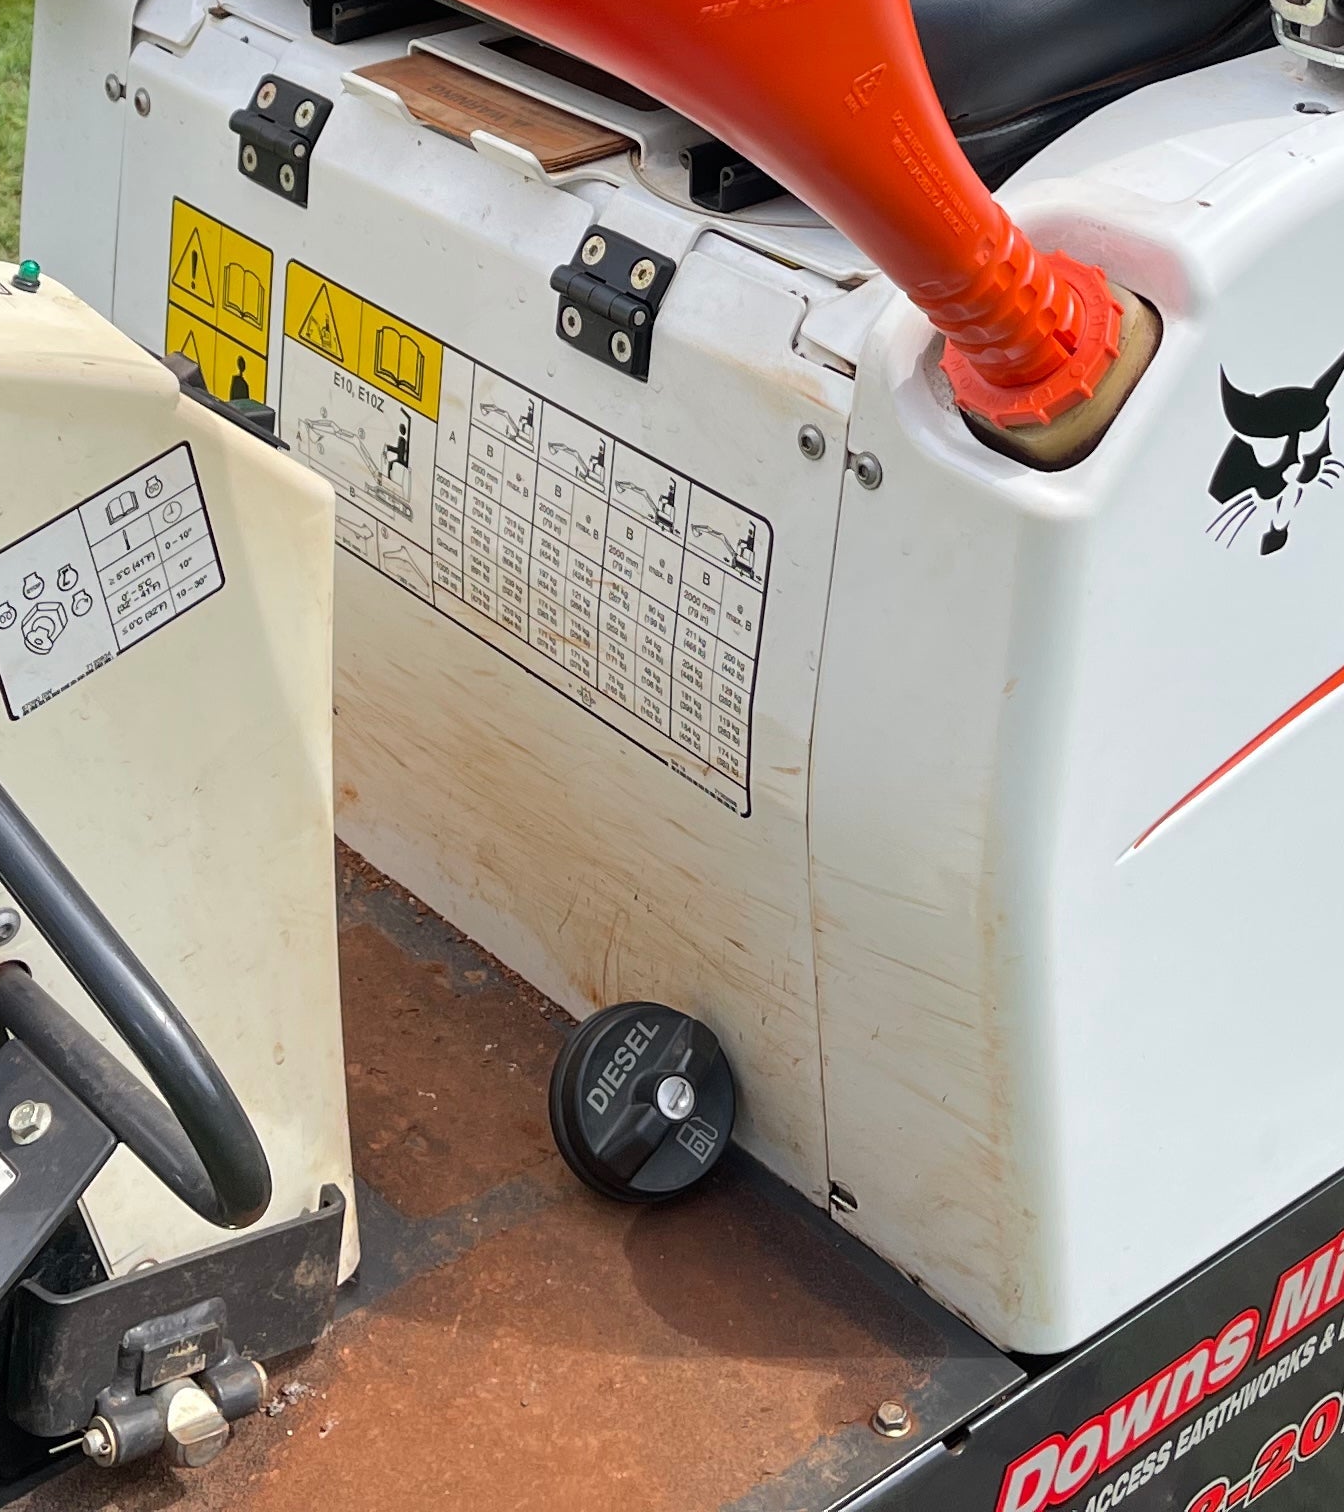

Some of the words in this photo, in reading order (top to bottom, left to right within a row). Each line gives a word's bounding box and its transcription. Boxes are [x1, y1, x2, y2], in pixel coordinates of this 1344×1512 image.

[358, 386, 385, 414] E10Z
[449, 431, 456, 444] A
[486, 444, 494, 458] B
[522, 487, 529, 498] B
[554, 484, 562, 498] B
[593, 529, 599, 540] B
[626, 526, 634, 541] B
[608, 544, 625, 560] 2000
[625, 556, 638, 569] mm
[667, 573, 674, 585] B
[702, 571, 711, 586] B
[683, 589, 701, 607] 2000
[702, 602, 715, 615] mm
[687, 605, 699, 619] (79
[745, 620, 752, 632] B
[685, 627, 697, 640] 211
[721, 662, 735, 677] (442
[585, 1020, 660, 1115] DIESEL
[996, 1309, 1259, 1512] Downs
[1085, 1440, 1173, 1512] ACCESS
[1173, 1335, 1318, 1461] EARTHWORKS
[1319, 1324, 1336, 1356] &
